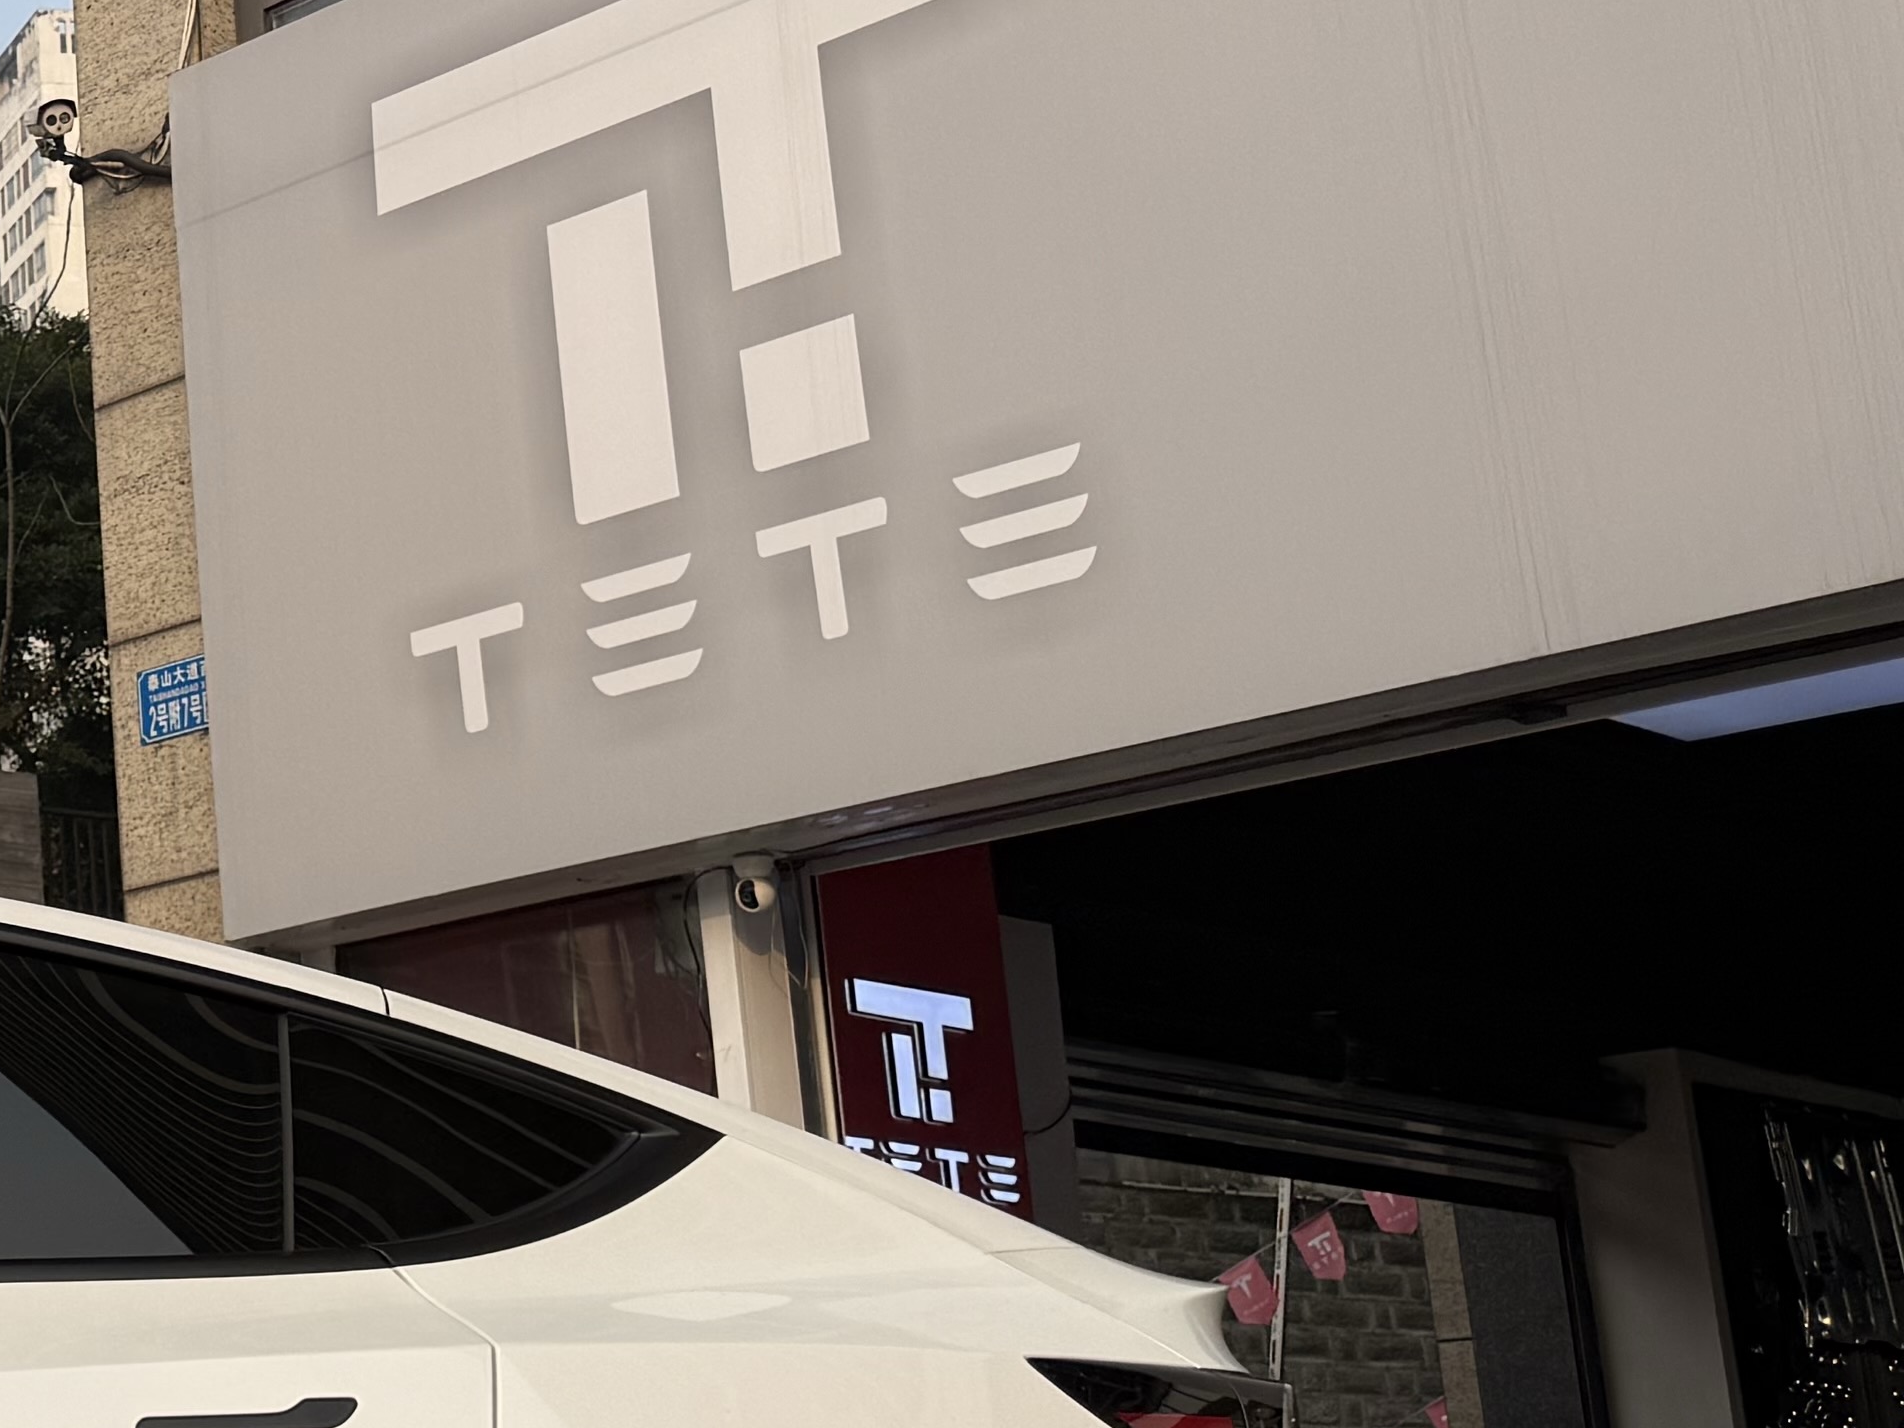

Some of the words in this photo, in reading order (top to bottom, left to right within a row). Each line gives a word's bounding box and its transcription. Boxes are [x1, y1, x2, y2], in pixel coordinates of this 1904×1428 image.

[410, 441, 1098, 734] TETE
[149, 691, 209, 737] 2号附7号
